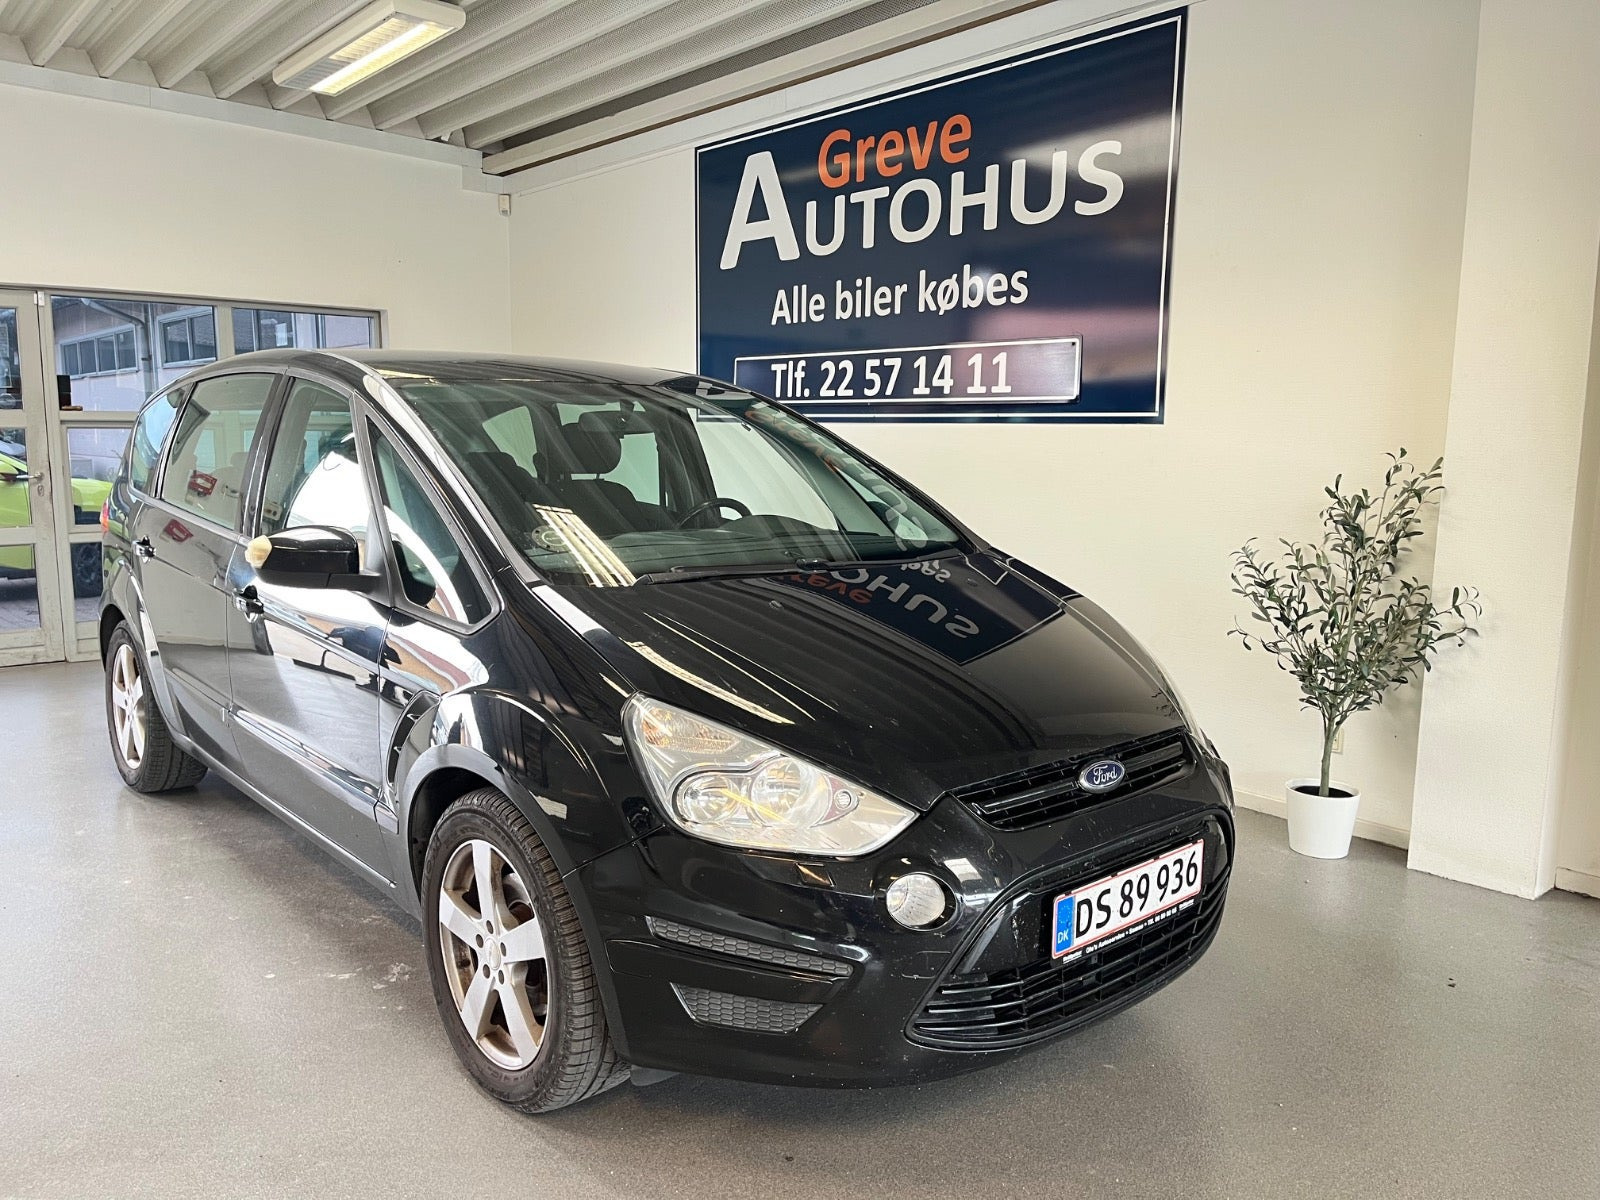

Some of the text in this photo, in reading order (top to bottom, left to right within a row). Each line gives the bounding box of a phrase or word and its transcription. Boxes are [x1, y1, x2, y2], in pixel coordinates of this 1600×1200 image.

[817, 114, 972, 189] Greve
[719, 140, 1125, 270] AUTOHUS
[771, 264, 1029, 326] Alle biler købes
[771, 352, 1012, 398] Tlf. 22 57 14 11
[1092, 764, 1118, 785] Ford
[1075, 851, 1198, 939] DS 89 936
[1057, 928, 1069, 945] DK
